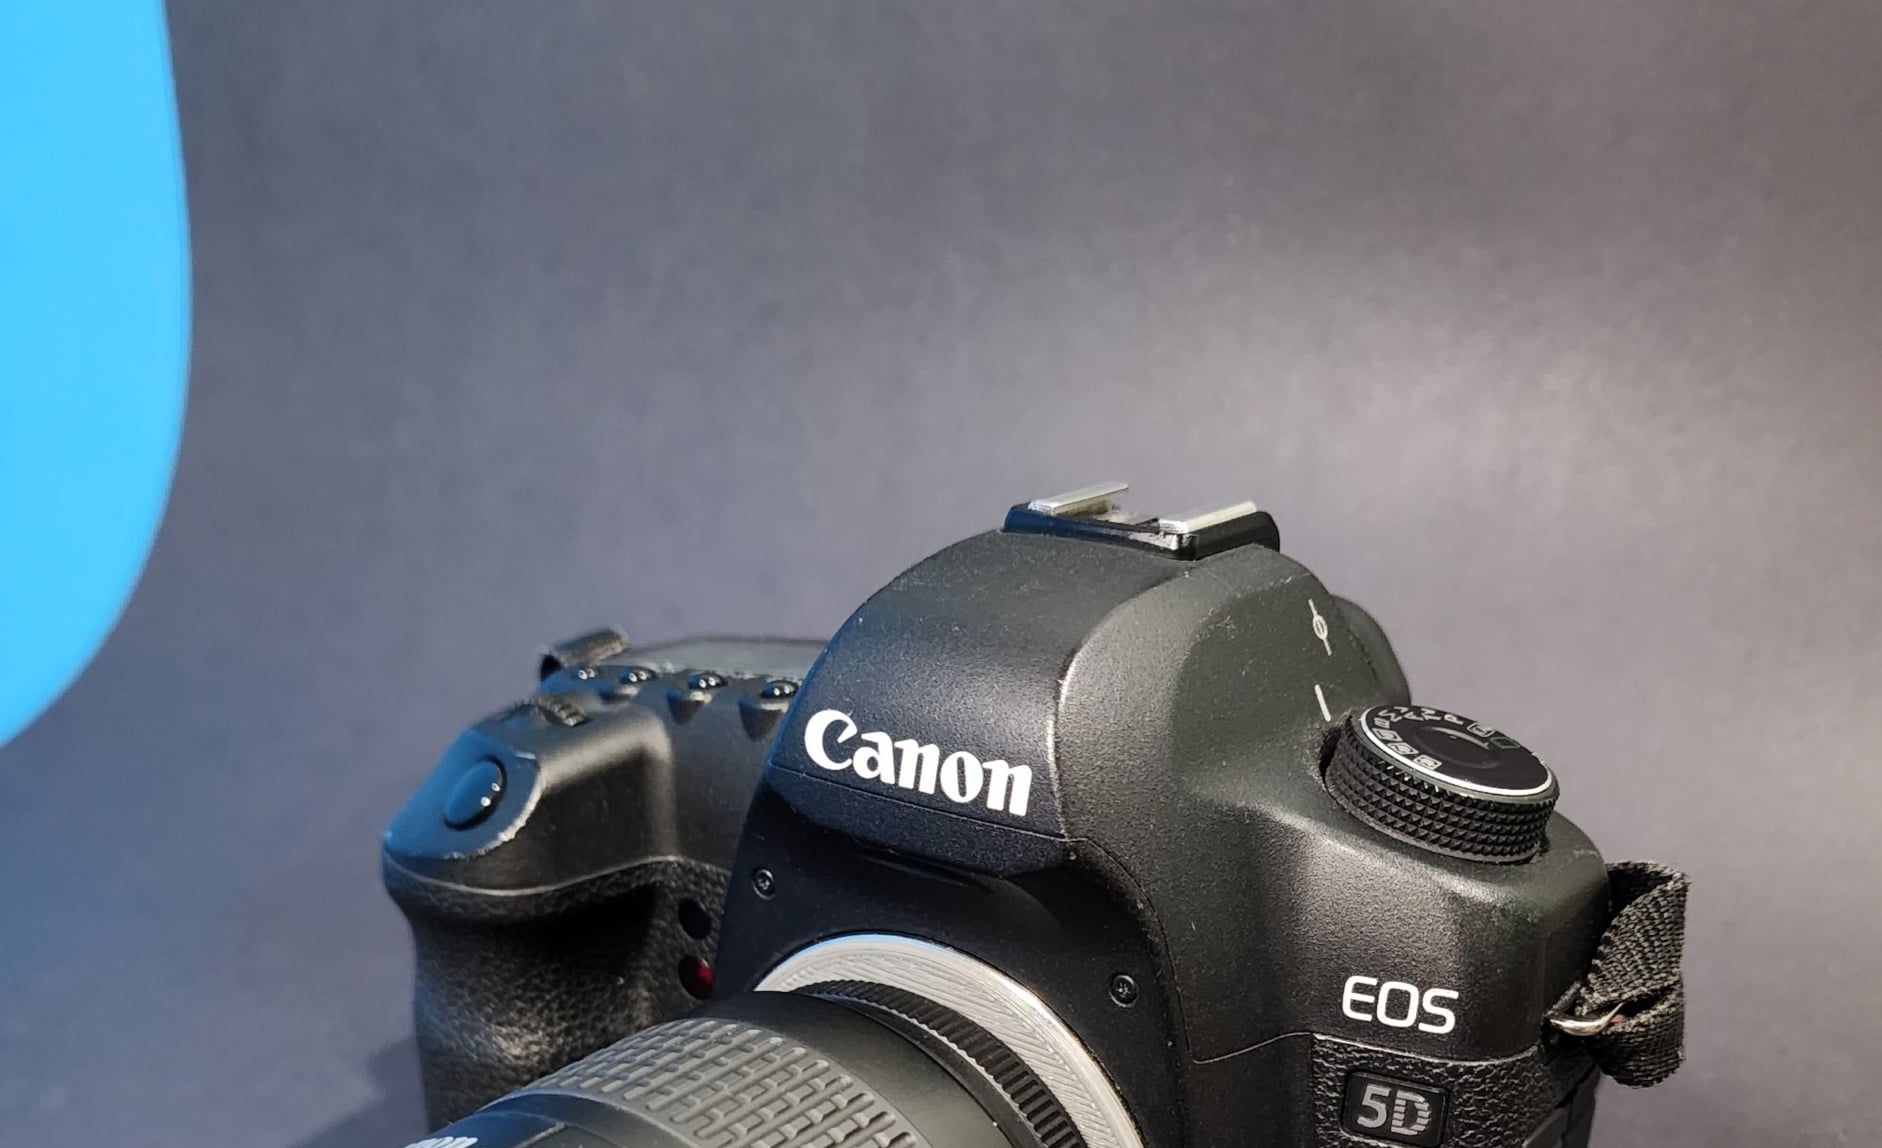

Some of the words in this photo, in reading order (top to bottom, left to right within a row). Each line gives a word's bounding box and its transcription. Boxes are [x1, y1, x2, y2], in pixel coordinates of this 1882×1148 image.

[1444, 714, 1464, 725] P
[804, 709, 1032, 817] Canon
[1342, 975, 1459, 1034] EOS
[1357, 1084, 1431, 1136] 5D
